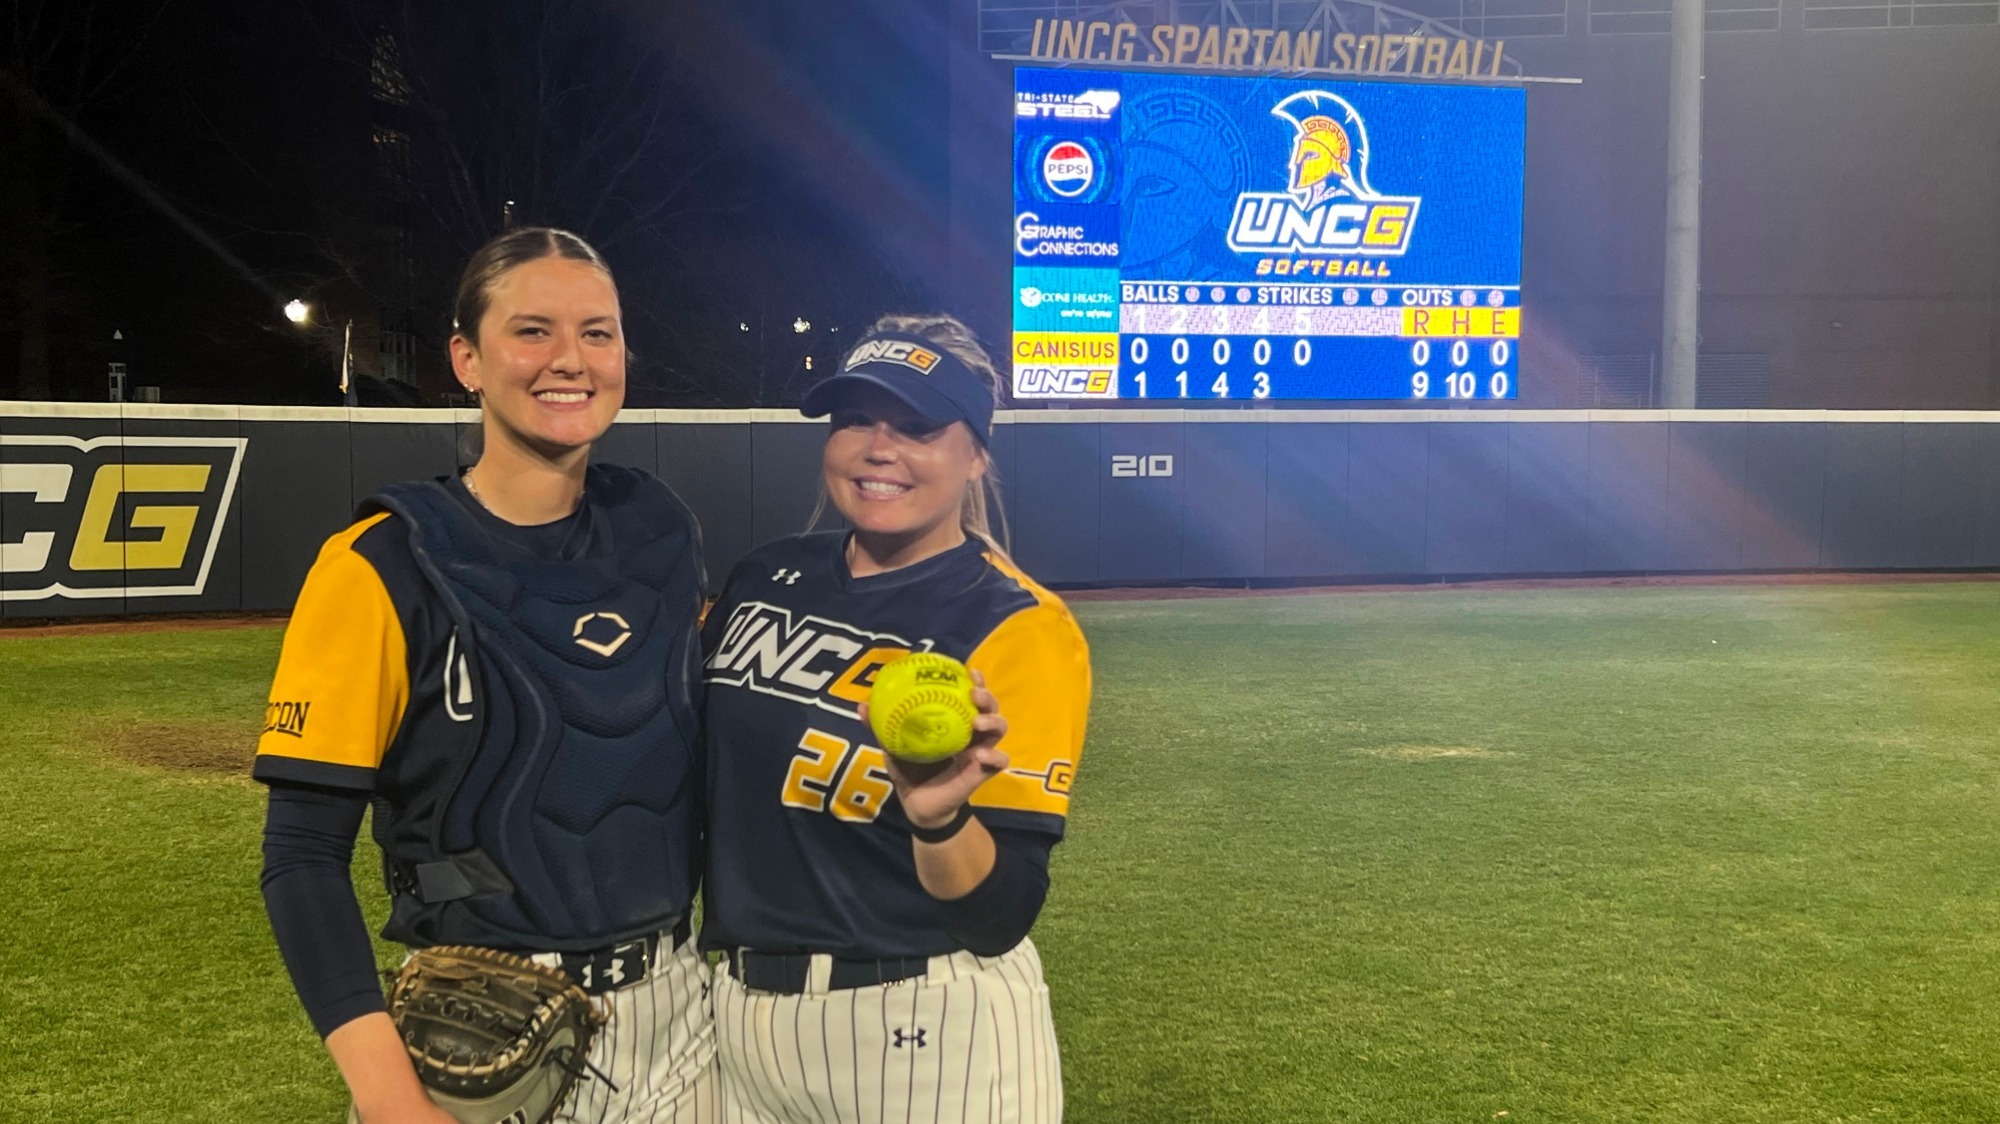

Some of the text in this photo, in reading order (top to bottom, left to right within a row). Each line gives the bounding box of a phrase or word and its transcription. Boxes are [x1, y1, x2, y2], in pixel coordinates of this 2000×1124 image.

[1031, 19, 1504, 77] UNCG SPARTAN SOFTBALL
[1017, 91, 1074, 103] TRI-STATE
[1016, 102, 1111, 119] STEEL
[1048, 163, 1089, 175] PEPSI
[1016, 212, 1084, 239] GRAPHIC
[1234, 200, 1412, 246] UNCG
[1016, 236, 1119, 257] CONNECTIONS
[1256, 258, 1391, 276] SOFTBALL
[1121, 285, 1453, 306] BALLS STRIKES OUTS
[1133, 307, 1506, 335] 1 2 3 4 5 R H E
[847, 341, 936, 372] UNCG
[1017, 337, 1509, 367] CANISIUS 0 0 0 0 0 0 0 0
[1018, 368, 1508, 398] UNCG 1 1 4 3 9 10 0
[1111, 455, 1173, 477] 210
[915, 670, 958, 684] NCAA
[781, 728, 896, 823] 26
